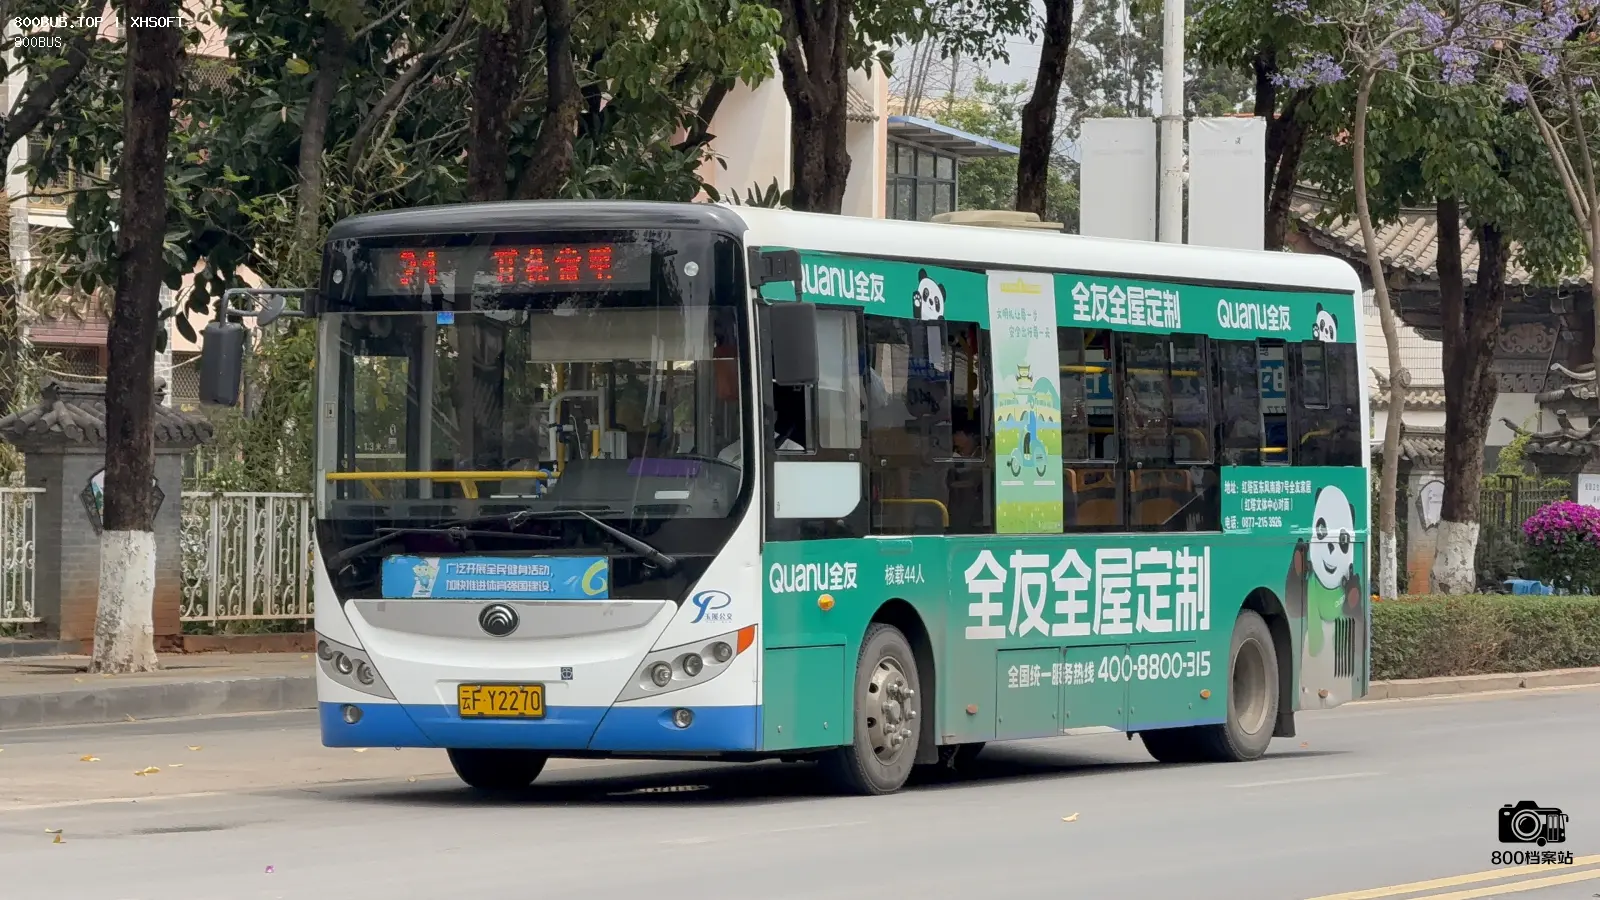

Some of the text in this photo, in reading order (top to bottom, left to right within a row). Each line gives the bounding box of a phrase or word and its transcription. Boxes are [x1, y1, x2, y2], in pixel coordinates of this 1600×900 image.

[800, 263, 886, 303] uanu全友
[1071, 281, 1181, 329] 全友全屋定制
[1216, 298, 1292, 331] Quanu全友
[769, 561, 858, 594] Quanu全友
[884, 564, 925, 586] 核载44人
[964, 546, 1211, 640] 全友全屋定制
[1008, 660, 1095, 688] 全国统一服务热线
